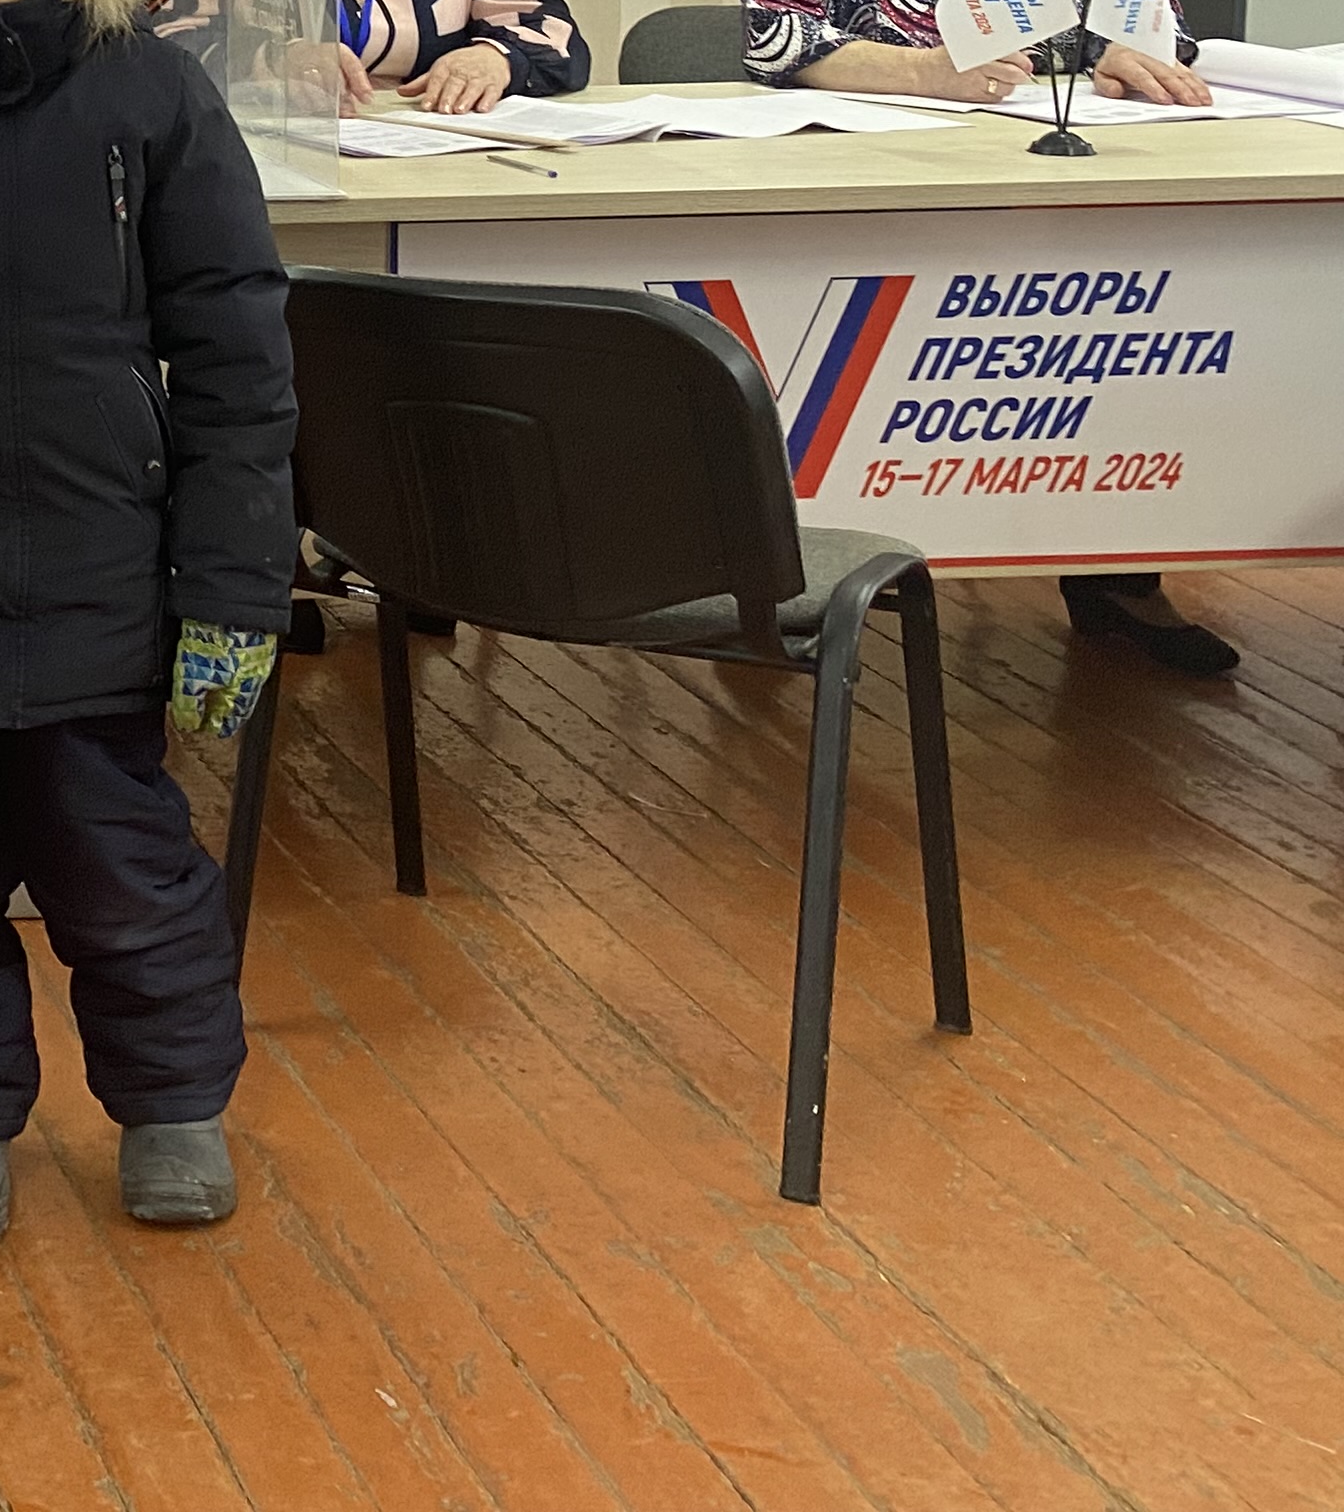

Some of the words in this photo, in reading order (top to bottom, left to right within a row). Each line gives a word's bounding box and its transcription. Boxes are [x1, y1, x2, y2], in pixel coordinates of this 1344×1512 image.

[972, 12, 993, 34] 2024
[936, 270, 1171, 319] ВЫБОРЫ
[908, 331, 1234, 384] ПРЕЗИДЕНТА
[880, 395, 1093, 444] РОССИИ
[962, 454, 1089, 495] МАРТА
[1093, 452, 1184, 492] 2024
